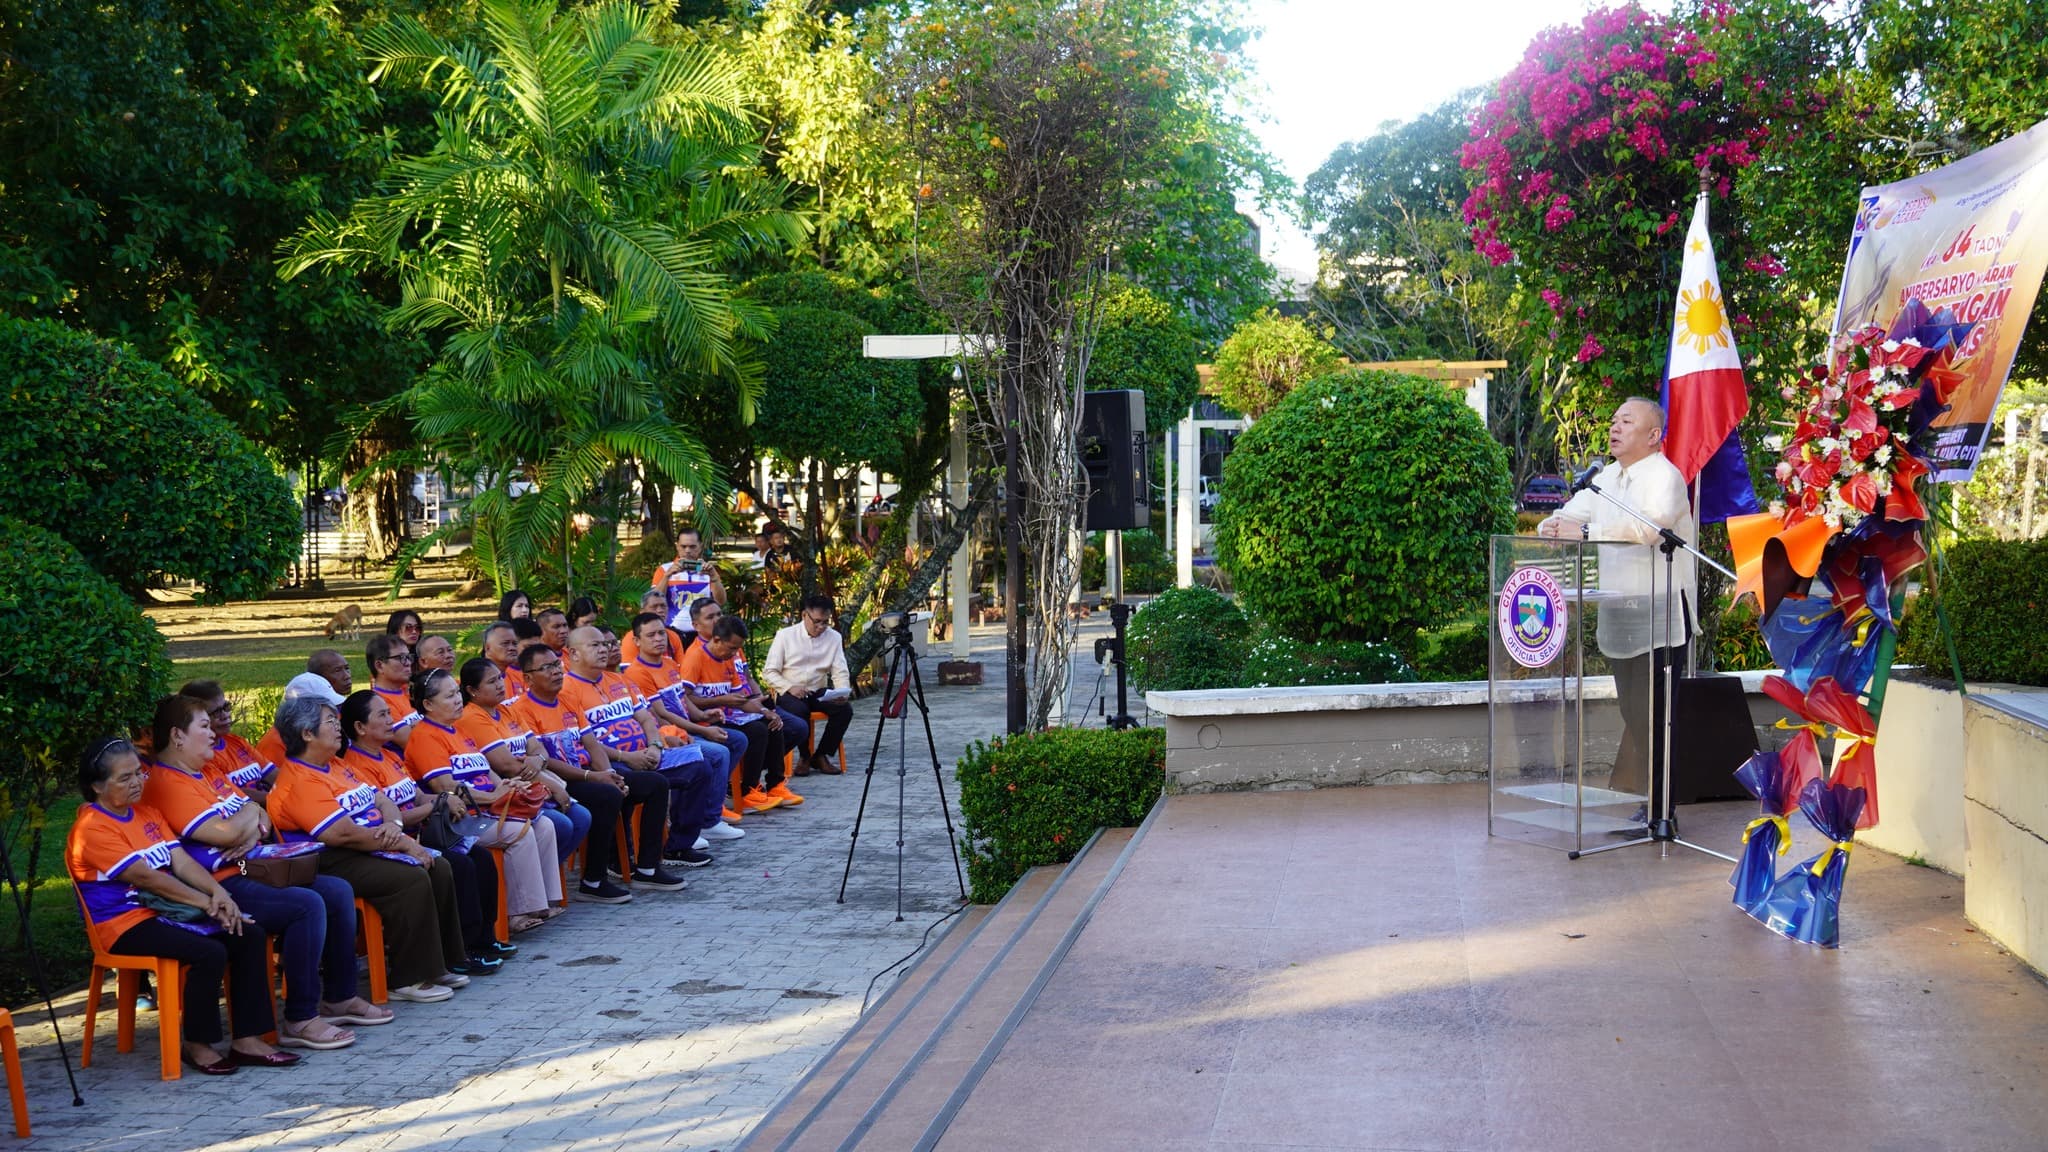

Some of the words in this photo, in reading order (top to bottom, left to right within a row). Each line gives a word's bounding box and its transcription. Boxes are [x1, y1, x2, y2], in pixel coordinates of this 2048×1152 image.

[1983, 262, 2018, 283] ARAW
[1503, 579, 1517, 608] CITY
[1520, 571, 1531, 581] OF
[1535, 571, 1563, 612] OZAMIZ
[1507, 636, 1538, 663] OFFICIAL
[1540, 642, 1557, 660] SEAL
[588, 700, 633, 724] KANUN
